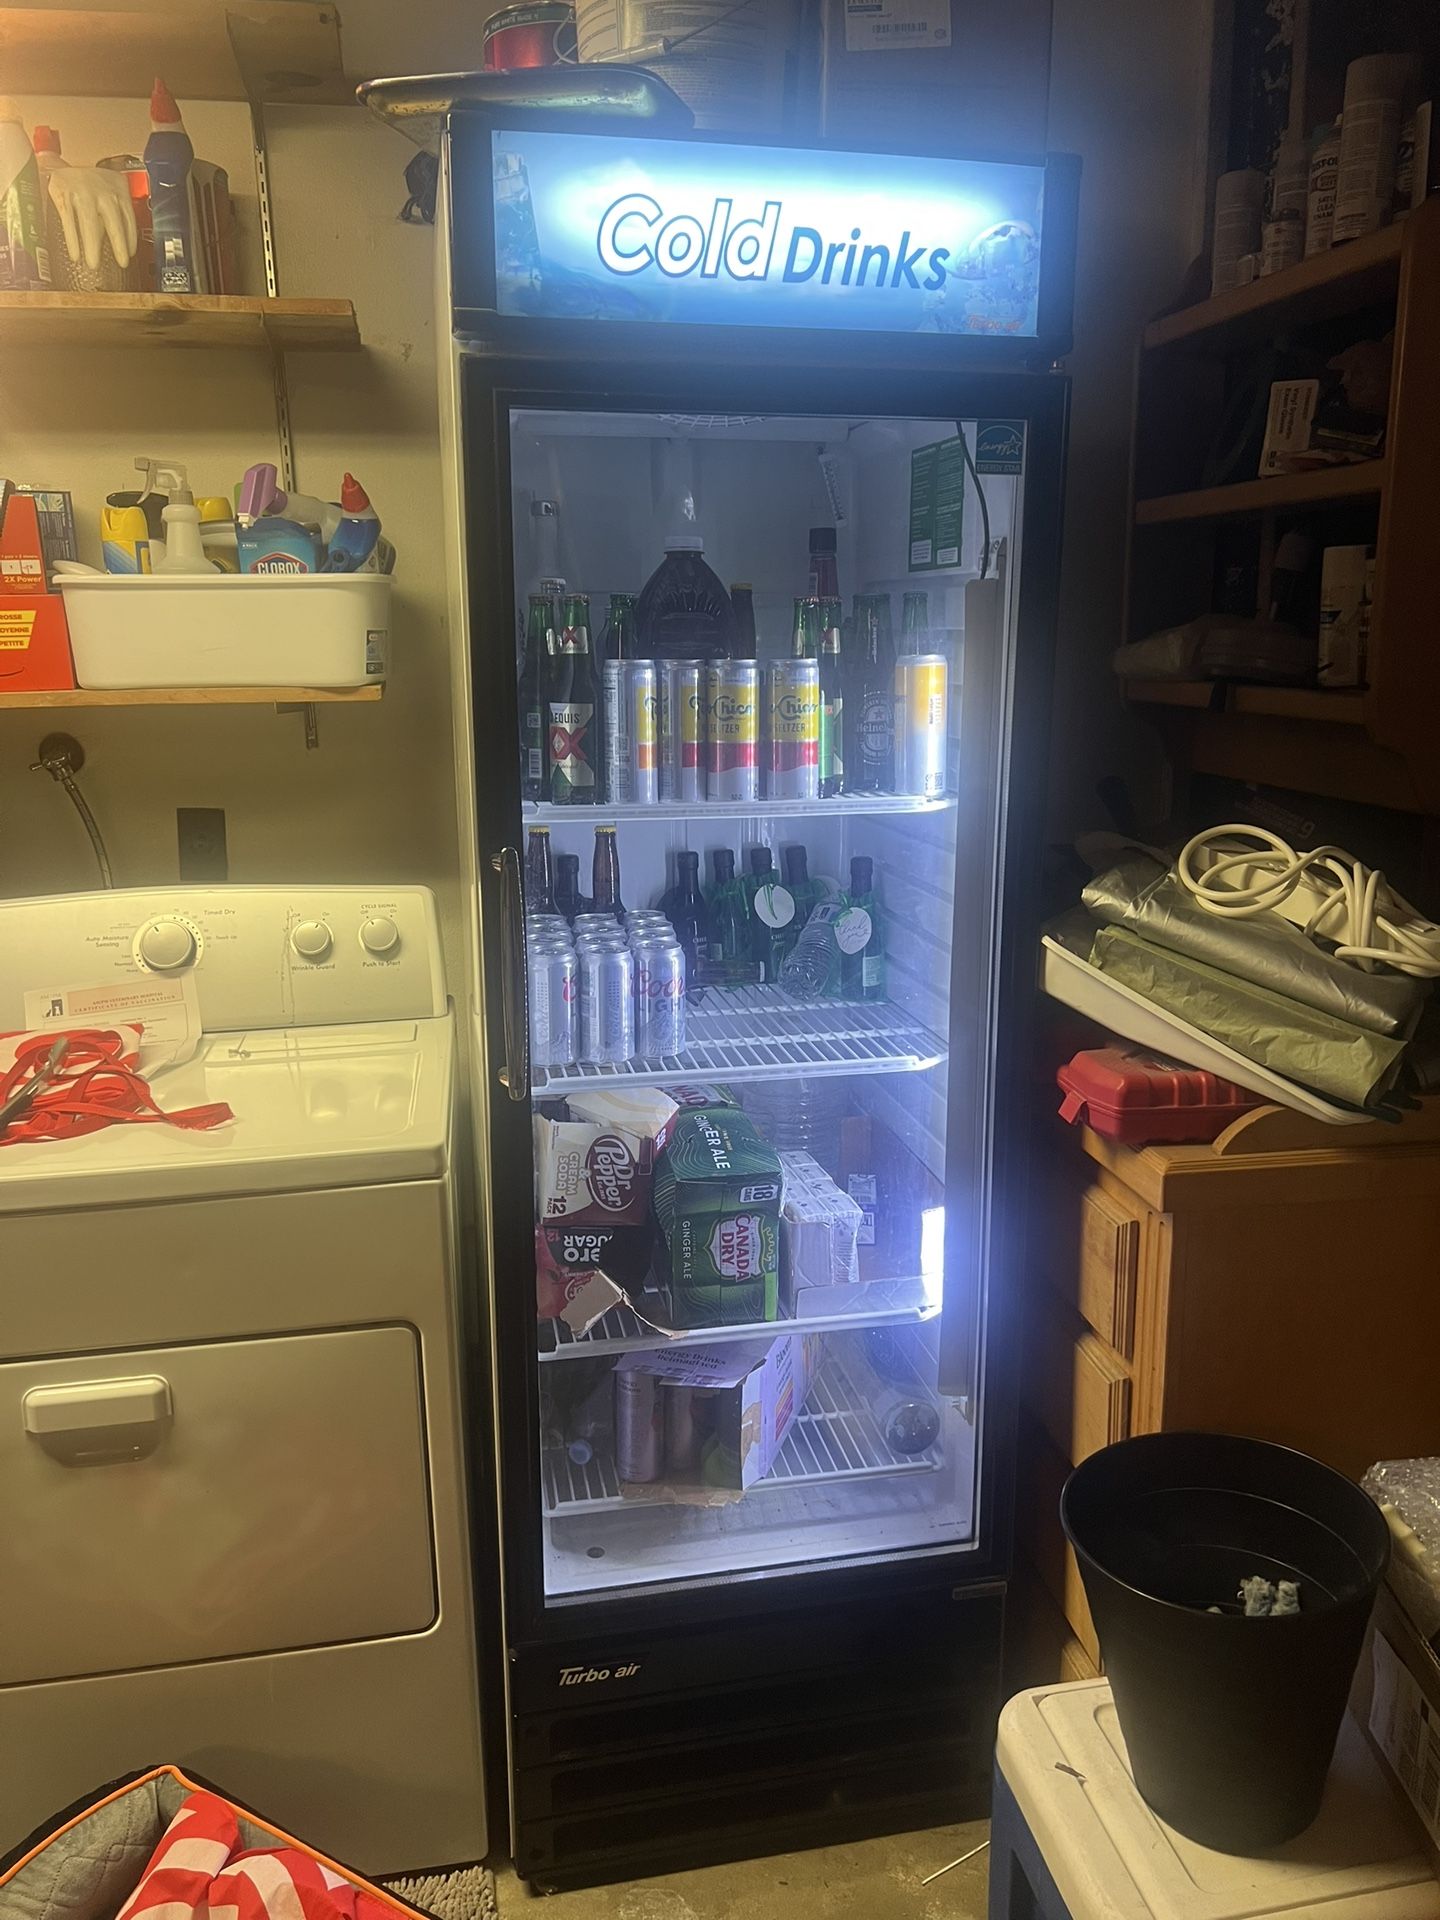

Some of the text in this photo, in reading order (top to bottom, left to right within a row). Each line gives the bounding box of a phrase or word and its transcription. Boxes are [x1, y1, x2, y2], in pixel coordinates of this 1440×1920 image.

[597, 193, 951, 291] Cold Drinks
[17, 575, 42, 583] Power
[554, 712, 581, 724] EQUIS
[694, 1114, 721, 1146] GINGER
[711, 1147, 731, 1169] ALE
[557, 1155, 569, 1191] SODA
[566, 1152, 579, 1195] CREAM
[579, 1167, 591, 1180] &
[594, 1139, 630, 1207] Pepper
[753, 1185, 774, 1200] 18
[552, 1195, 567, 1215] 12
[563, 1235, 614, 1247] UGAR
[682, 1220, 693, 1279] GINGER ALE
[721, 1232, 735, 1266] DRY
[735, 1214, 752, 1281] CANADA
[564, 1247, 600, 1262] ero
[654, 1348, 727, 1366] Energy Drinks
[559, 1662, 641, 1686] Turbo air
